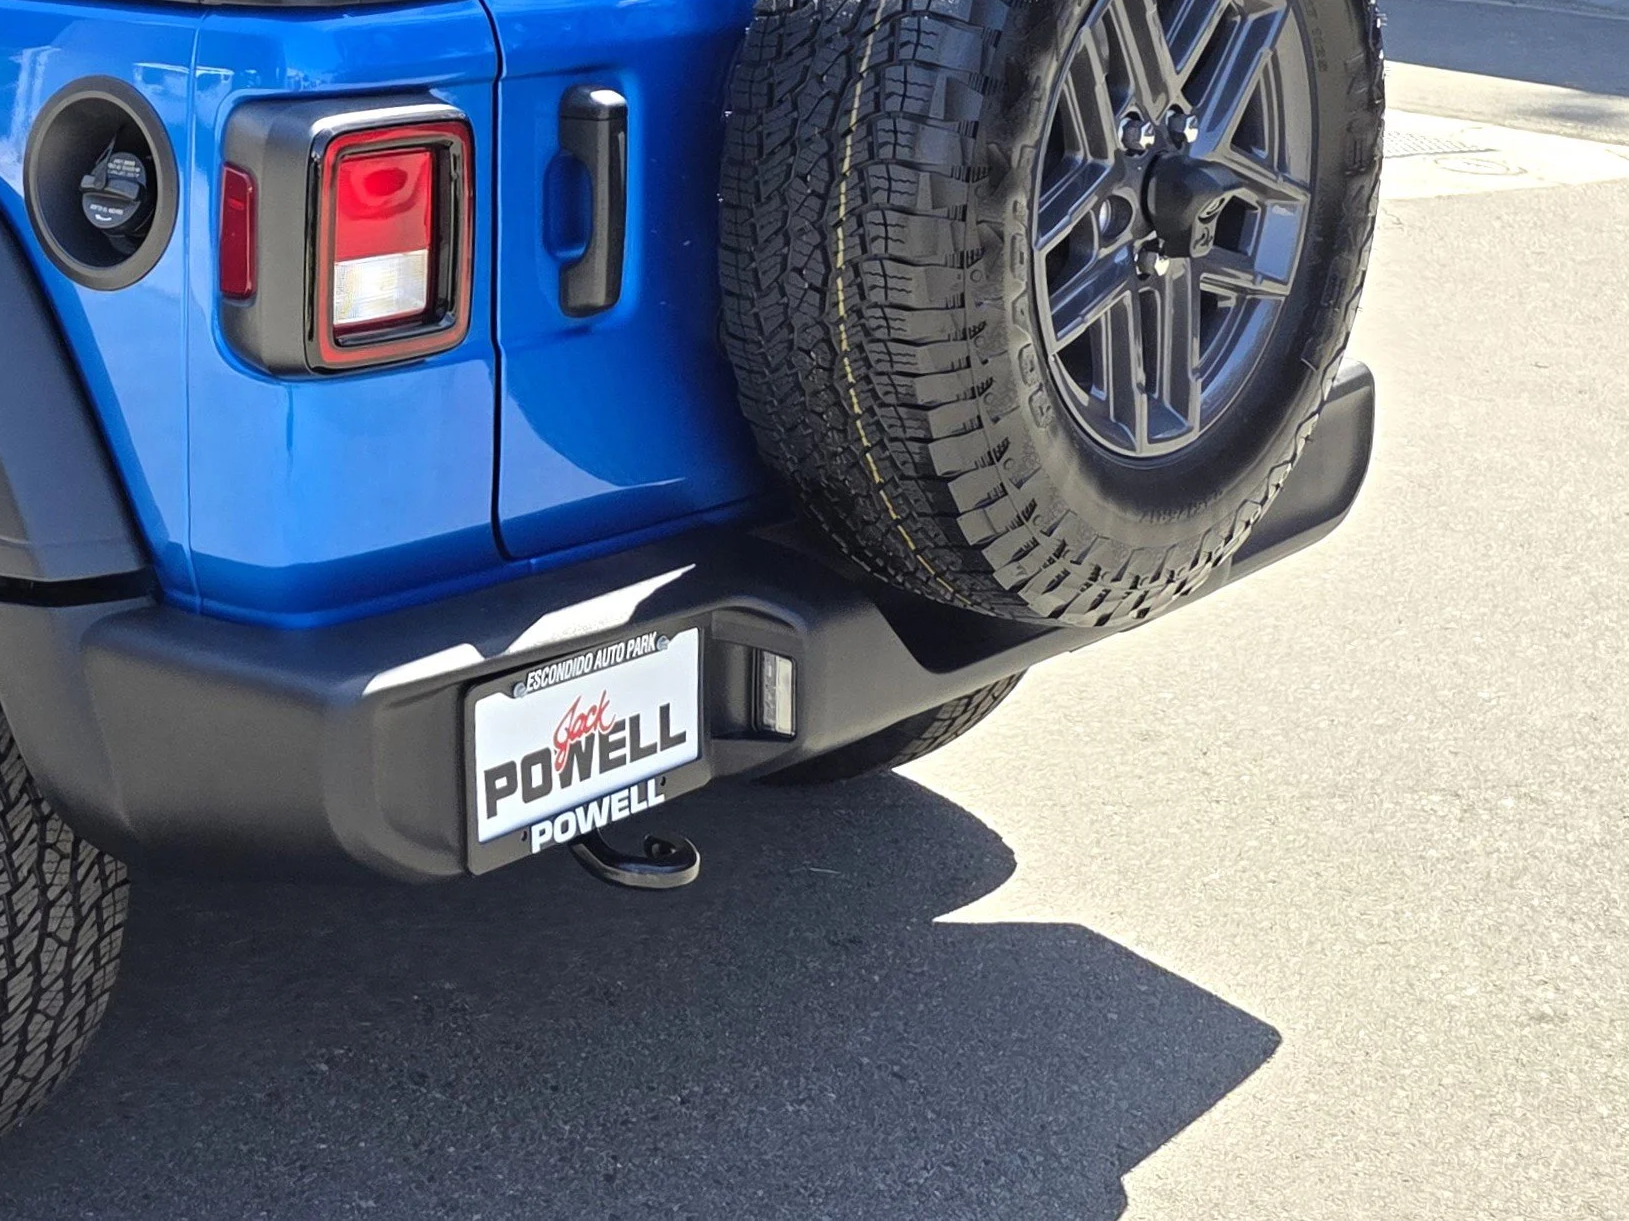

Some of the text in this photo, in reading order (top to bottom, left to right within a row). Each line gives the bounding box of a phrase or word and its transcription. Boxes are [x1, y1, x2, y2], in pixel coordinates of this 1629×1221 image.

[525, 631, 658, 692] ESCONDIDO AUTO PARK
[483, 703, 687, 820] POWELL
[552, 690, 616, 770] Jack
[529, 779, 666, 855] POWELL
